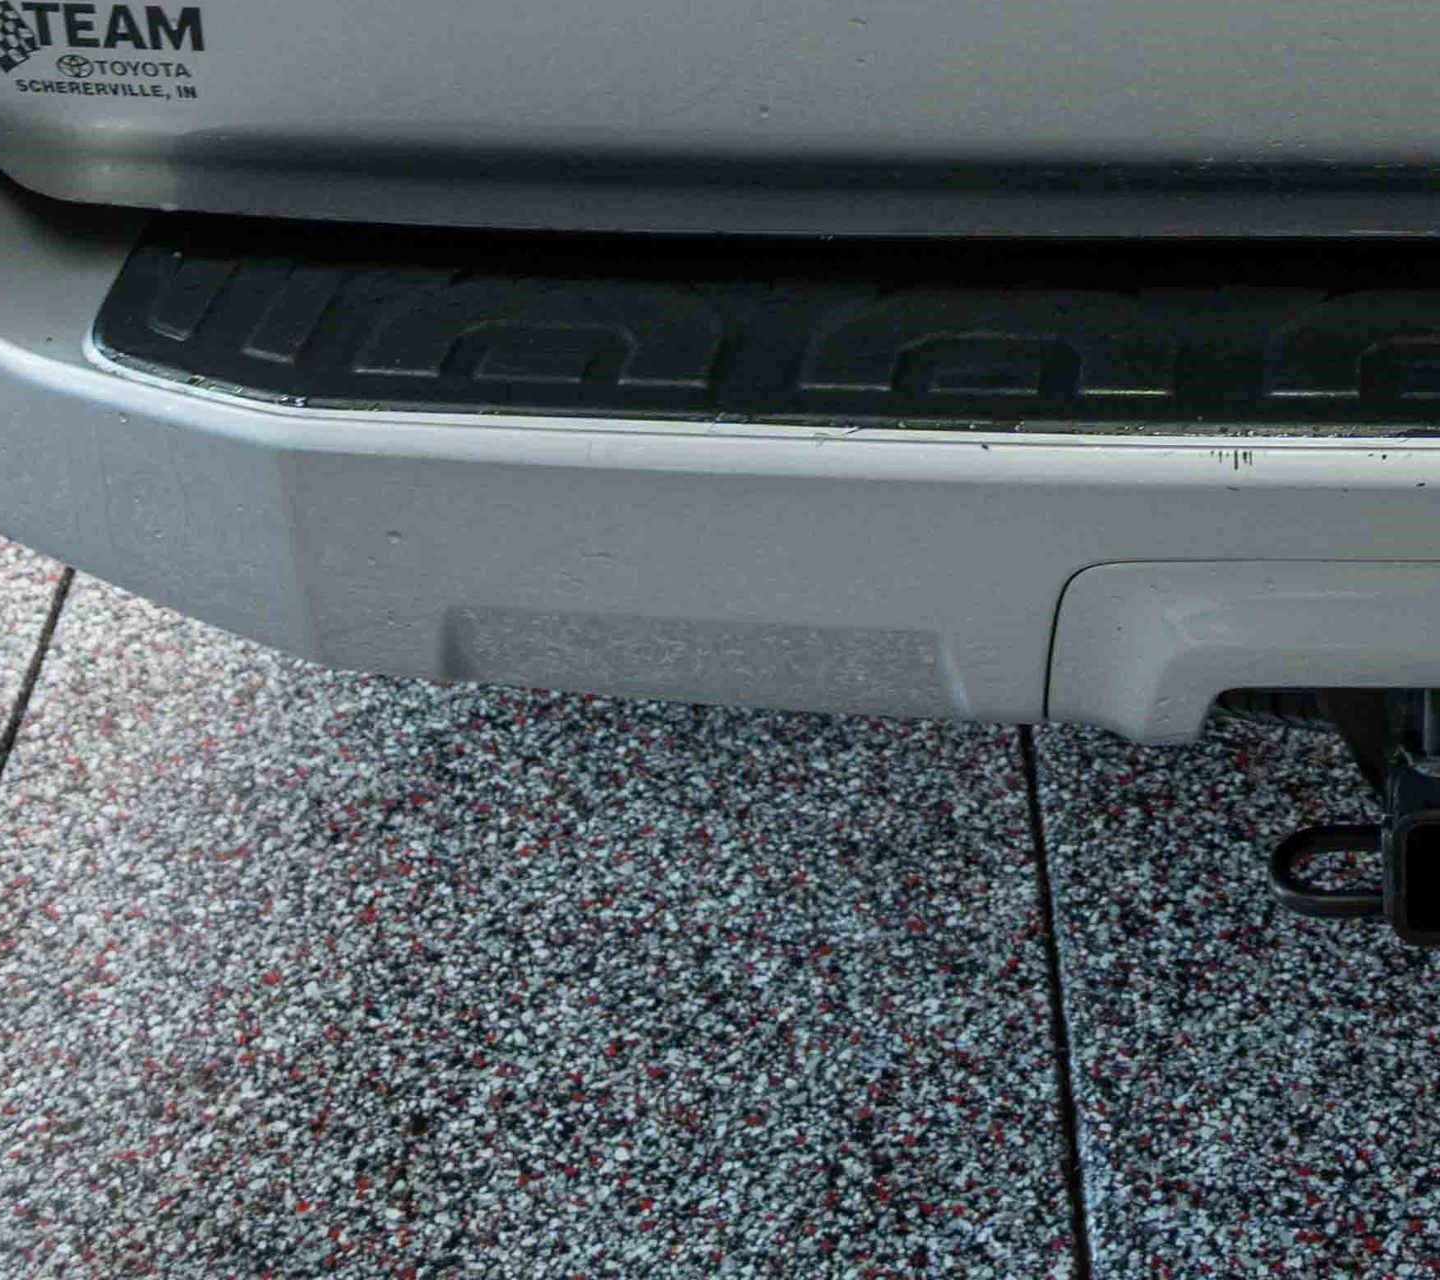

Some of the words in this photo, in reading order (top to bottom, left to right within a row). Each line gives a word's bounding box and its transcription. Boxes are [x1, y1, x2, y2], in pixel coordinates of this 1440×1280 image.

[22, 1, 205, 52] TEAM
[95, 60, 191, 78] TOYOTA
[16, 79, 172, 100] SCHERERVILLE,
[176, 85, 198, 98] IN
